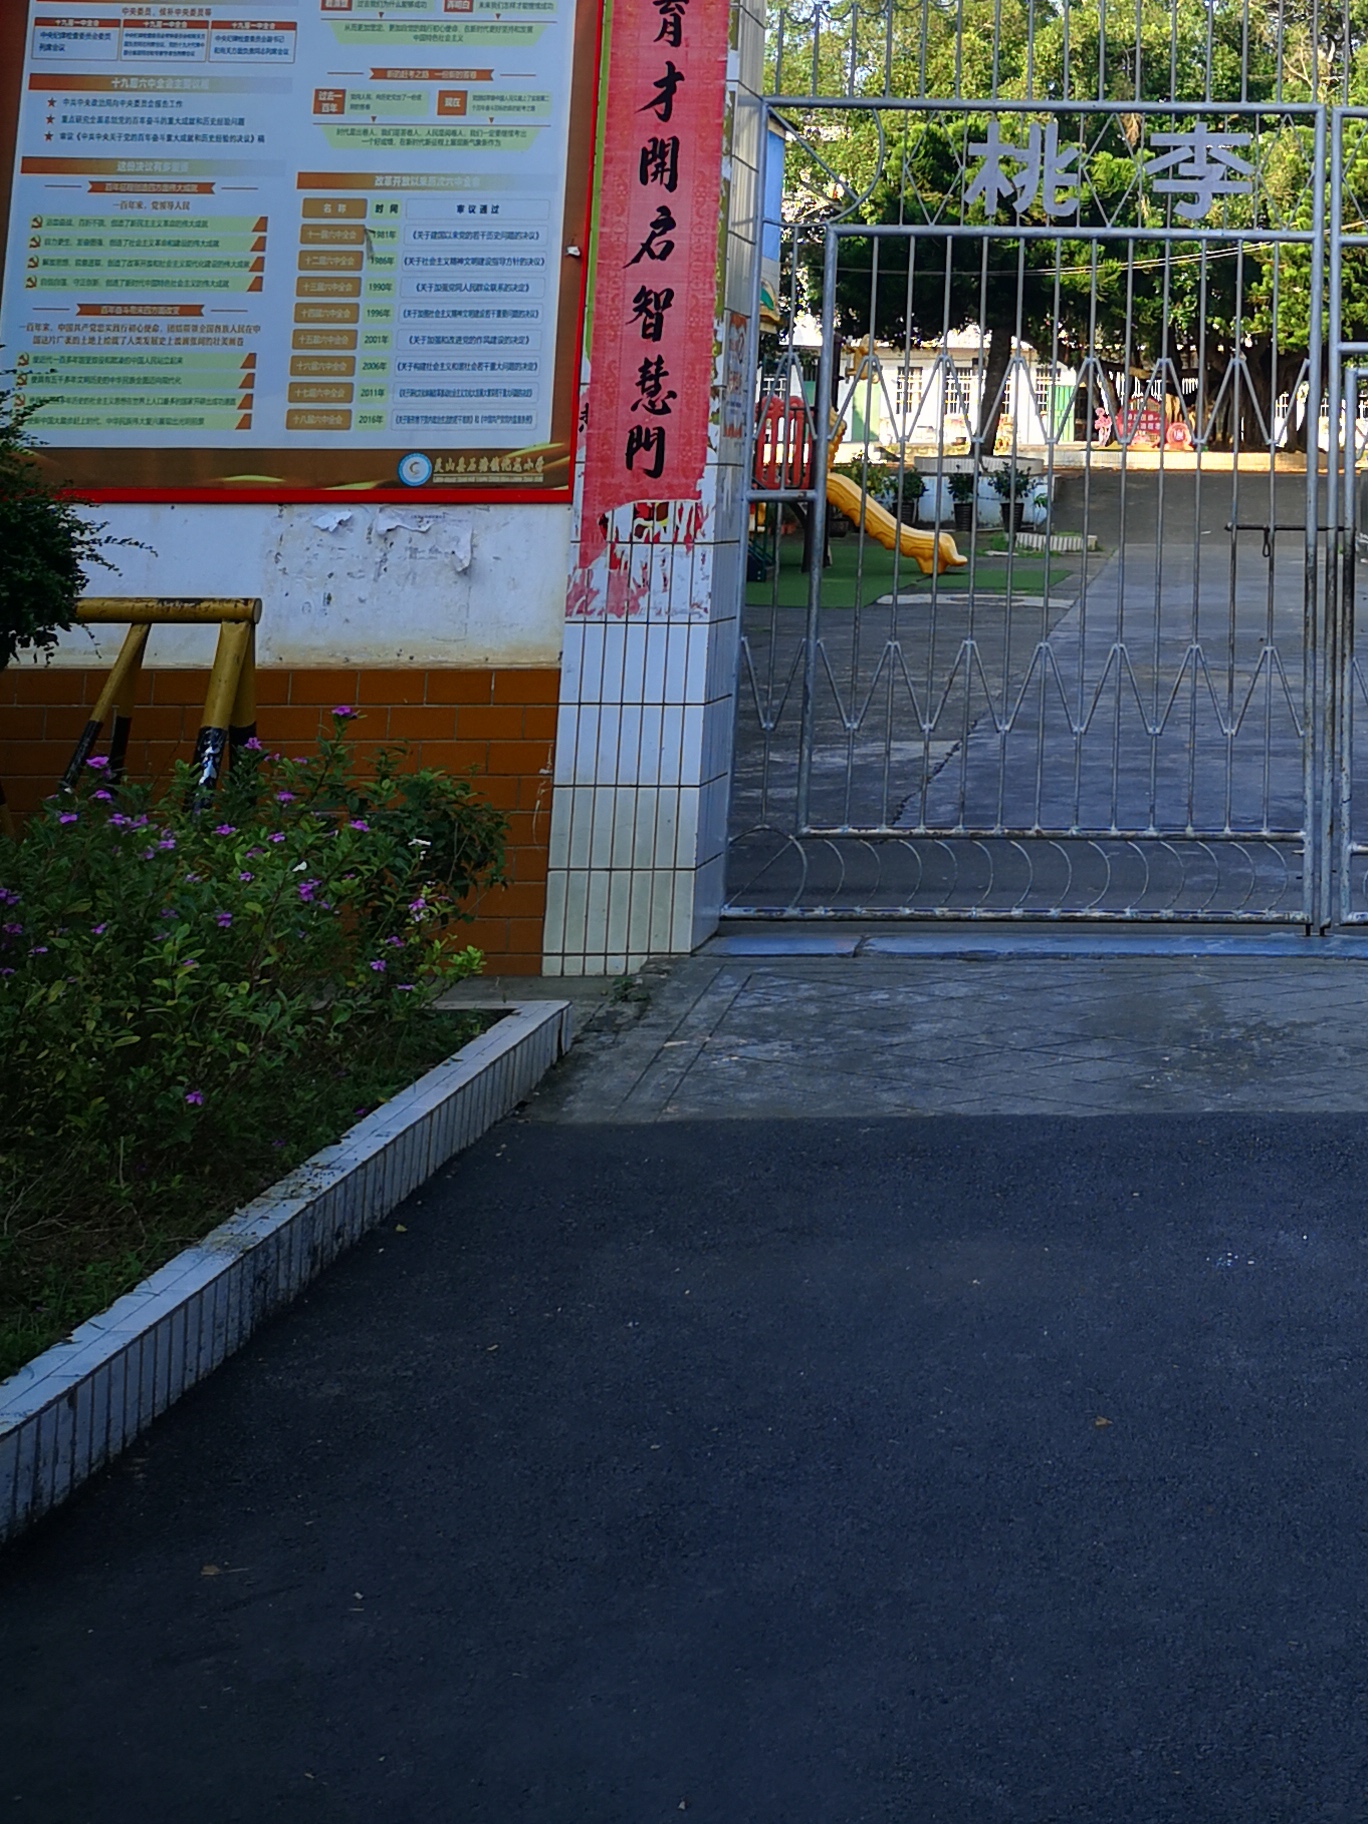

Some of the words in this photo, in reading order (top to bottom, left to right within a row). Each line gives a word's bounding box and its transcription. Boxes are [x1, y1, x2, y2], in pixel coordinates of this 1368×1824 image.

[368, 282, 392, 293] 1990年
[366, 308, 391, 319] 1996年
[364, 335, 389, 345] 2001年
[362, 361, 387, 371] 2006年
[360, 388, 385, 398] 2011年
[358, 414, 384, 424] 2016年
